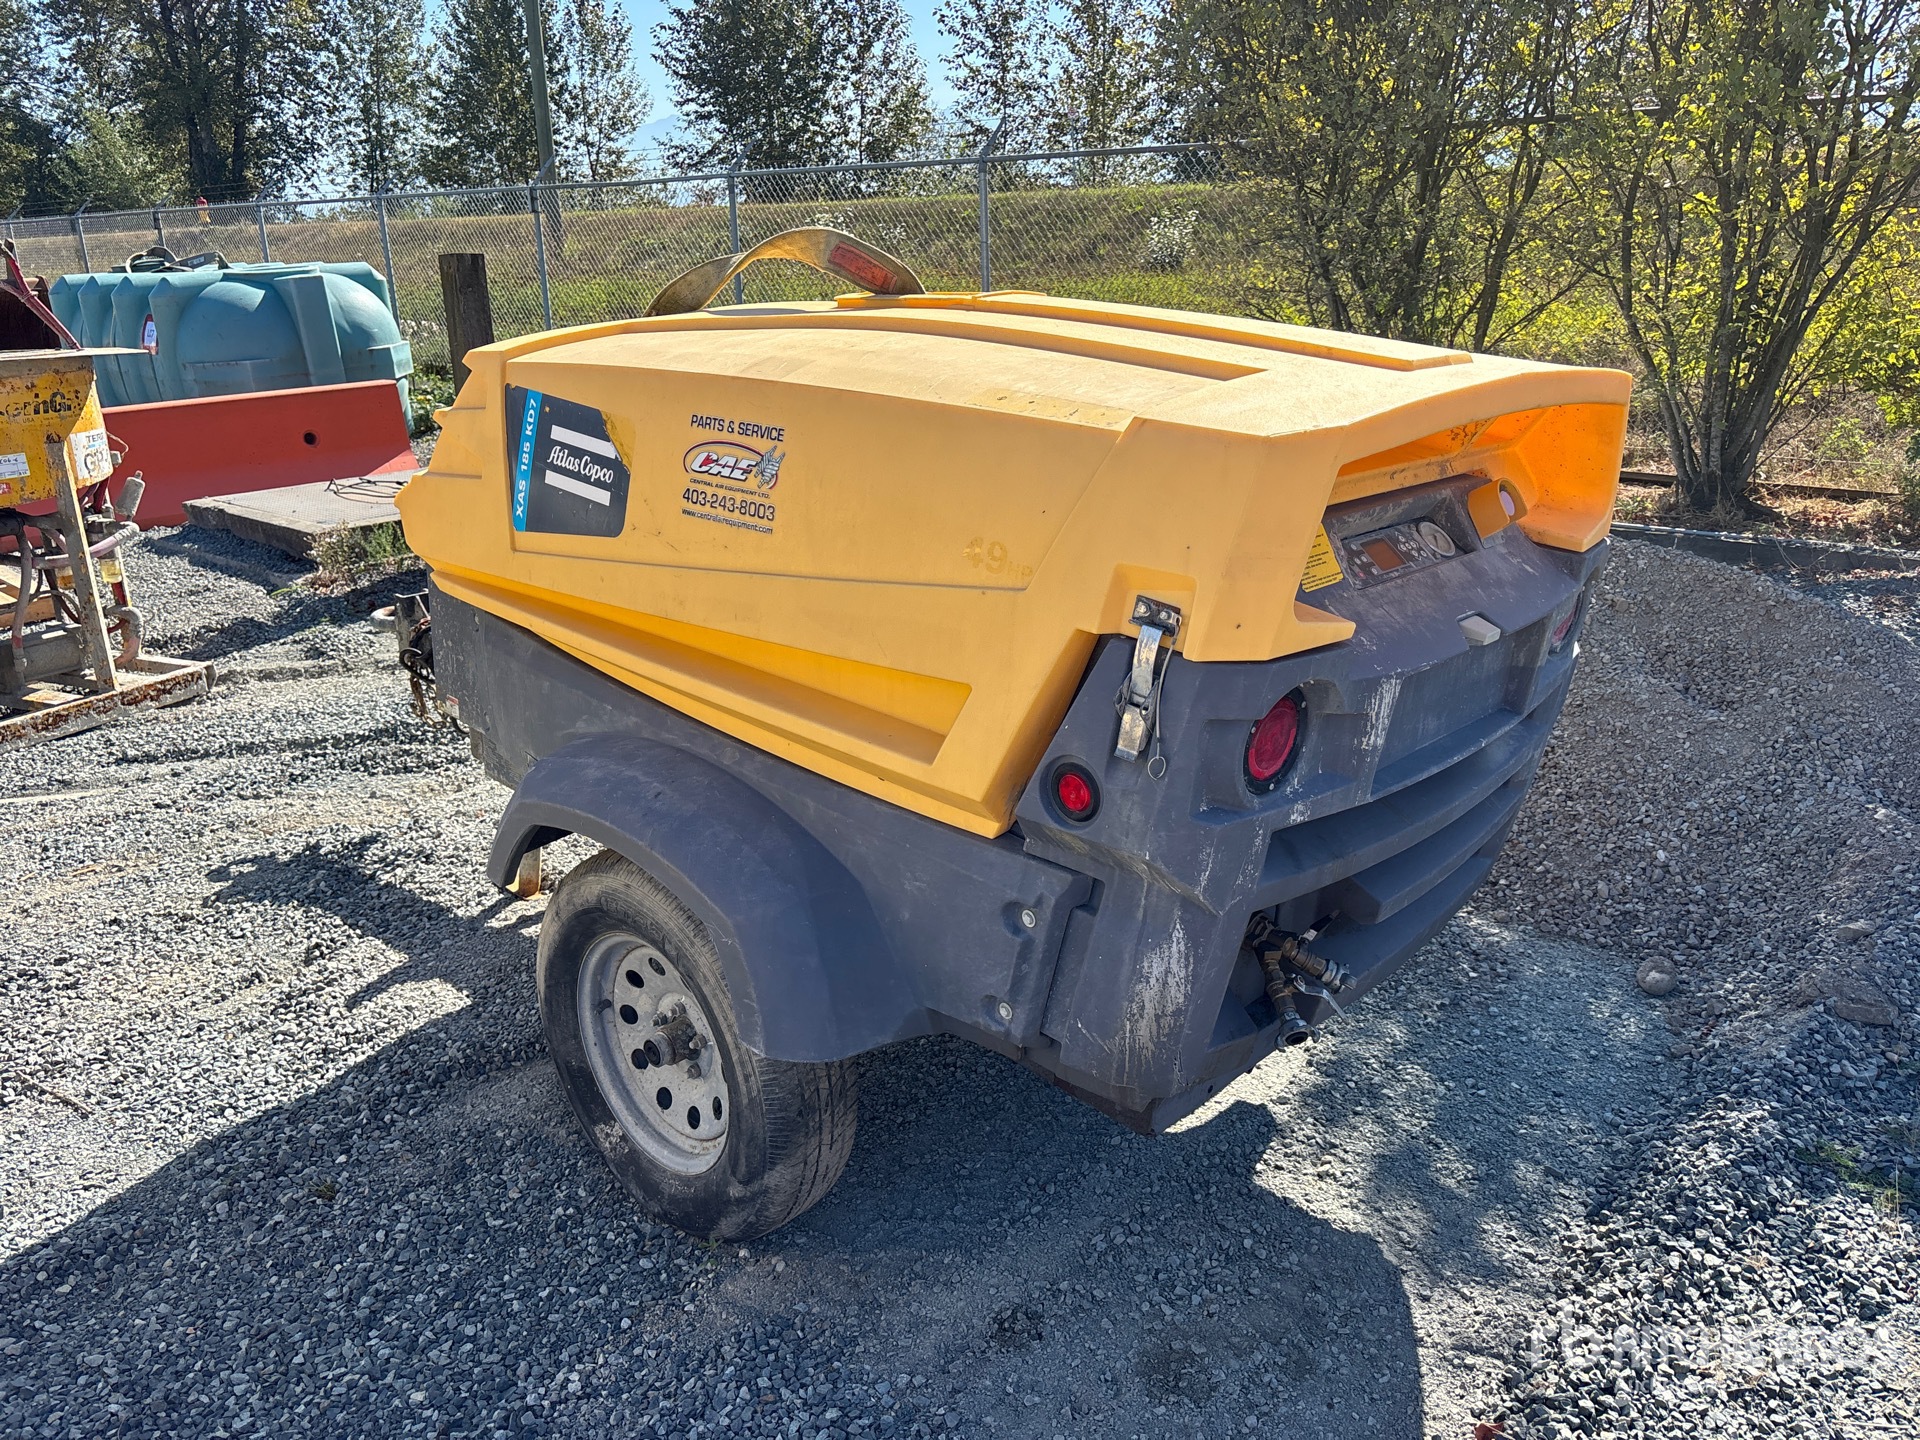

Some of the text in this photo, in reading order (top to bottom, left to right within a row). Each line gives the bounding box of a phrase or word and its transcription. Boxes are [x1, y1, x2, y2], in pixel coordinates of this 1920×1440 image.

[690, 414, 785, 442] PARTS & SERVICE
[515, 398, 537, 519] XAS 185 KD7
[546, 445, 614, 484] Atlas Copco
[690, 451, 757, 482] CAE
[682, 487, 775, 521] 403-243-8003
[689, 478, 714, 488] CENTRAL
[724, 485, 757, 496] EQUIPMENT
[757, 491, 771, 499] LTD.
[681, 507, 774, 535] www.centralairequipment.com
